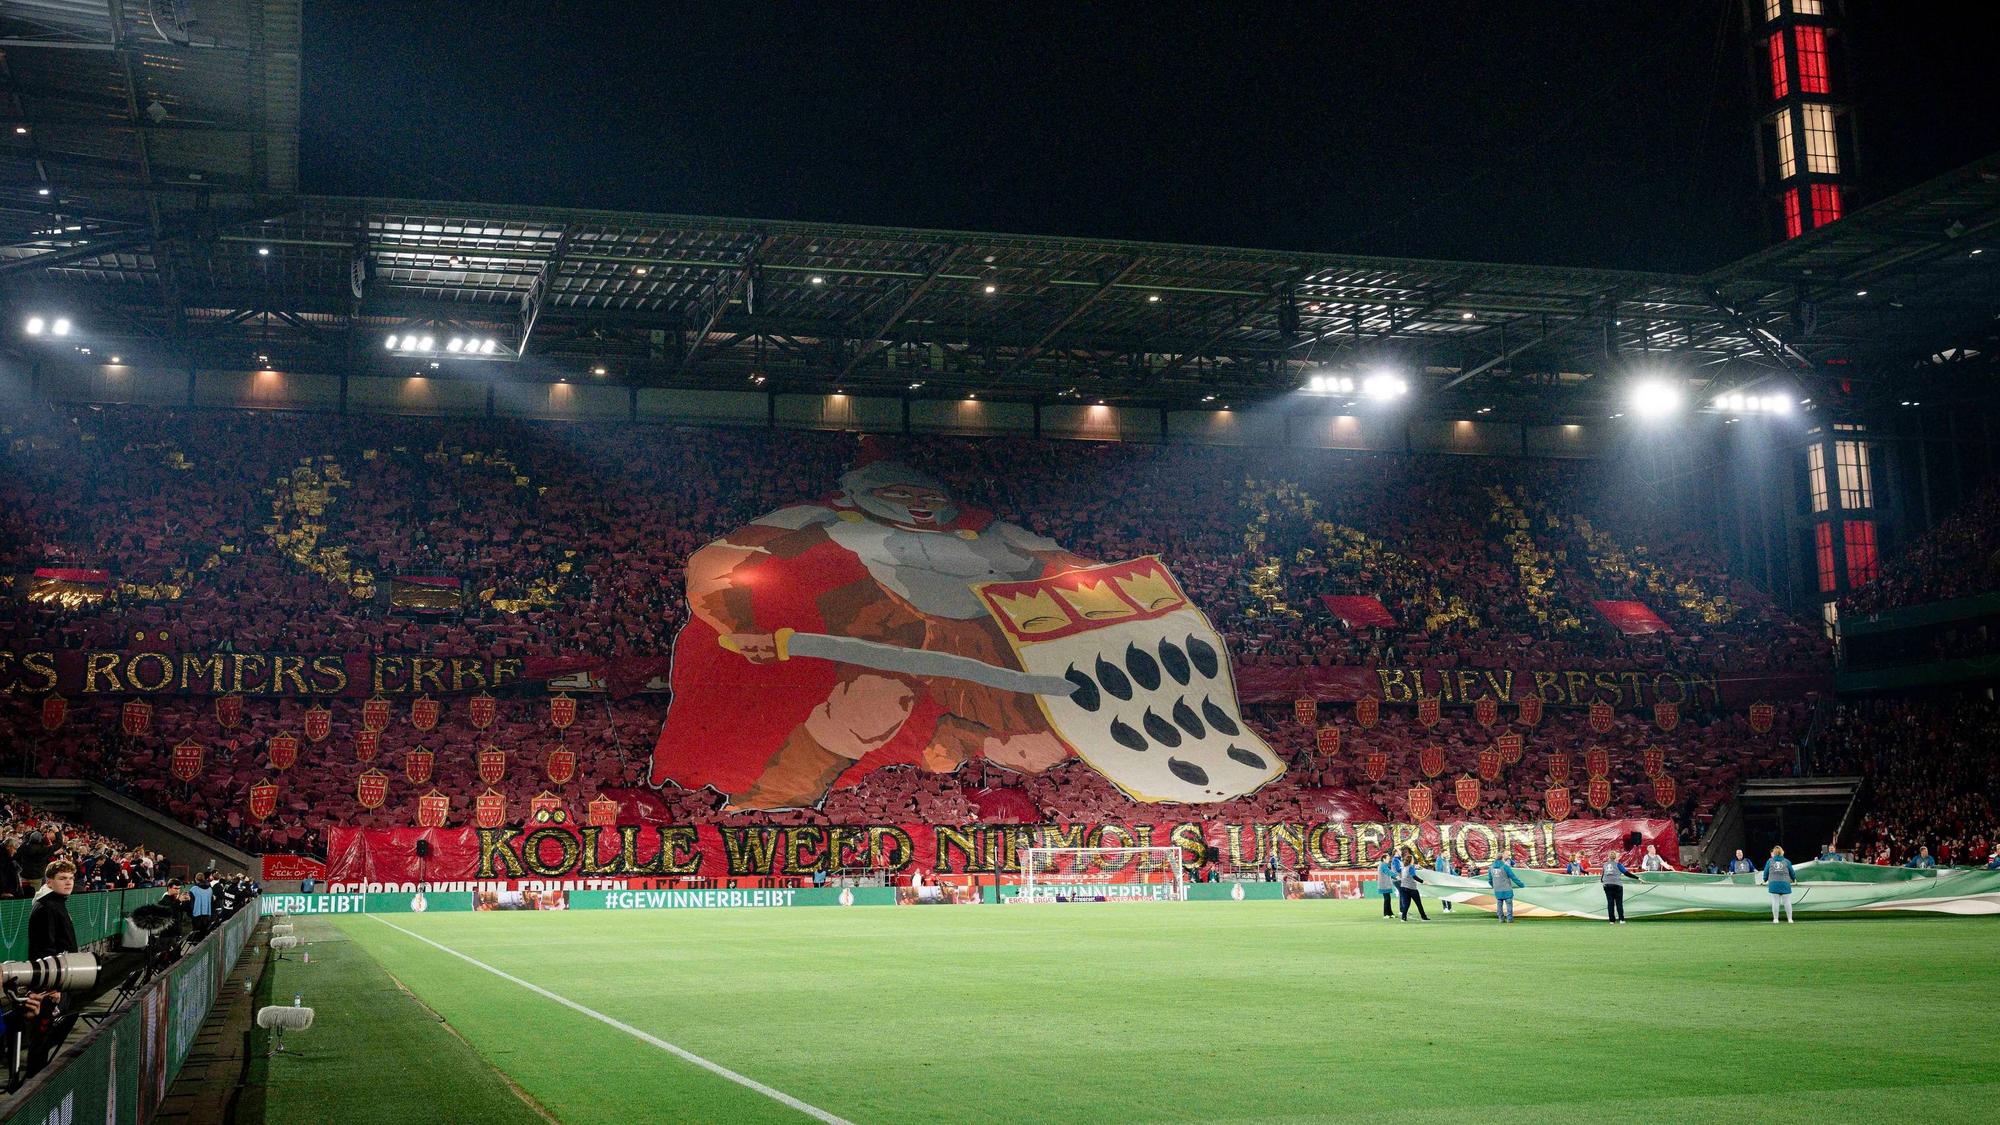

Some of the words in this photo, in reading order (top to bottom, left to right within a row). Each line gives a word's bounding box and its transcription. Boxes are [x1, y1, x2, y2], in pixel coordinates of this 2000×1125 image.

[82, 631, 347, 694] RÖMERS
[1377, 668, 1514, 704] BLIEV
[1532, 669, 1721, 708] BESTON
[479, 808, 702, 878] KÖLLE
[605, 890, 796, 908] #GEWINNERBLEIBT
